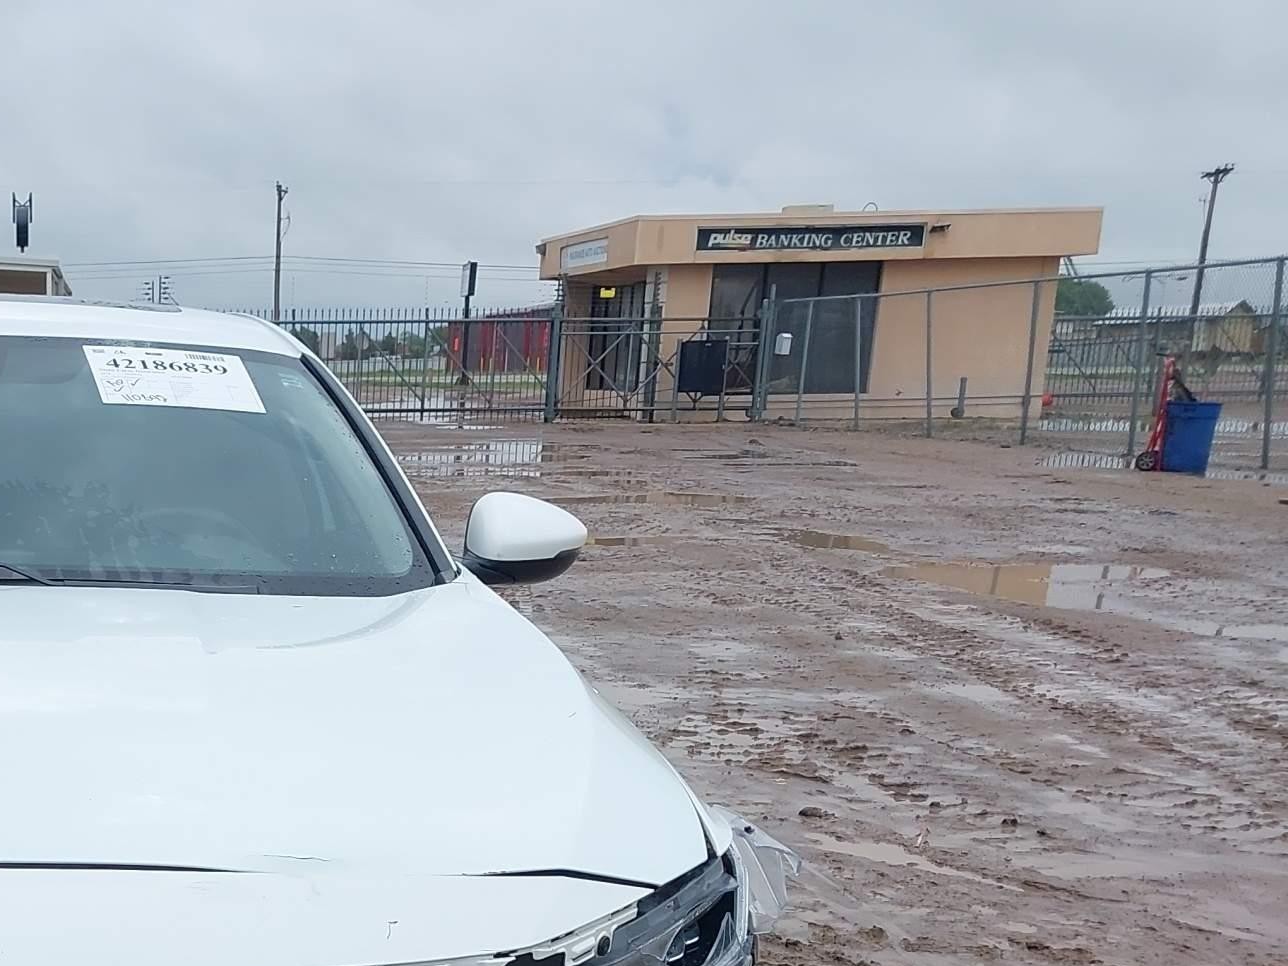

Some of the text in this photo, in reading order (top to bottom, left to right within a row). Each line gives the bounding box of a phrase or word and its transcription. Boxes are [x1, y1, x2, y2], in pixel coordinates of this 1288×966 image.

[707, 229, 912, 249] pulse BANKING CENTER
[105, 357, 228, 376] 42186839
